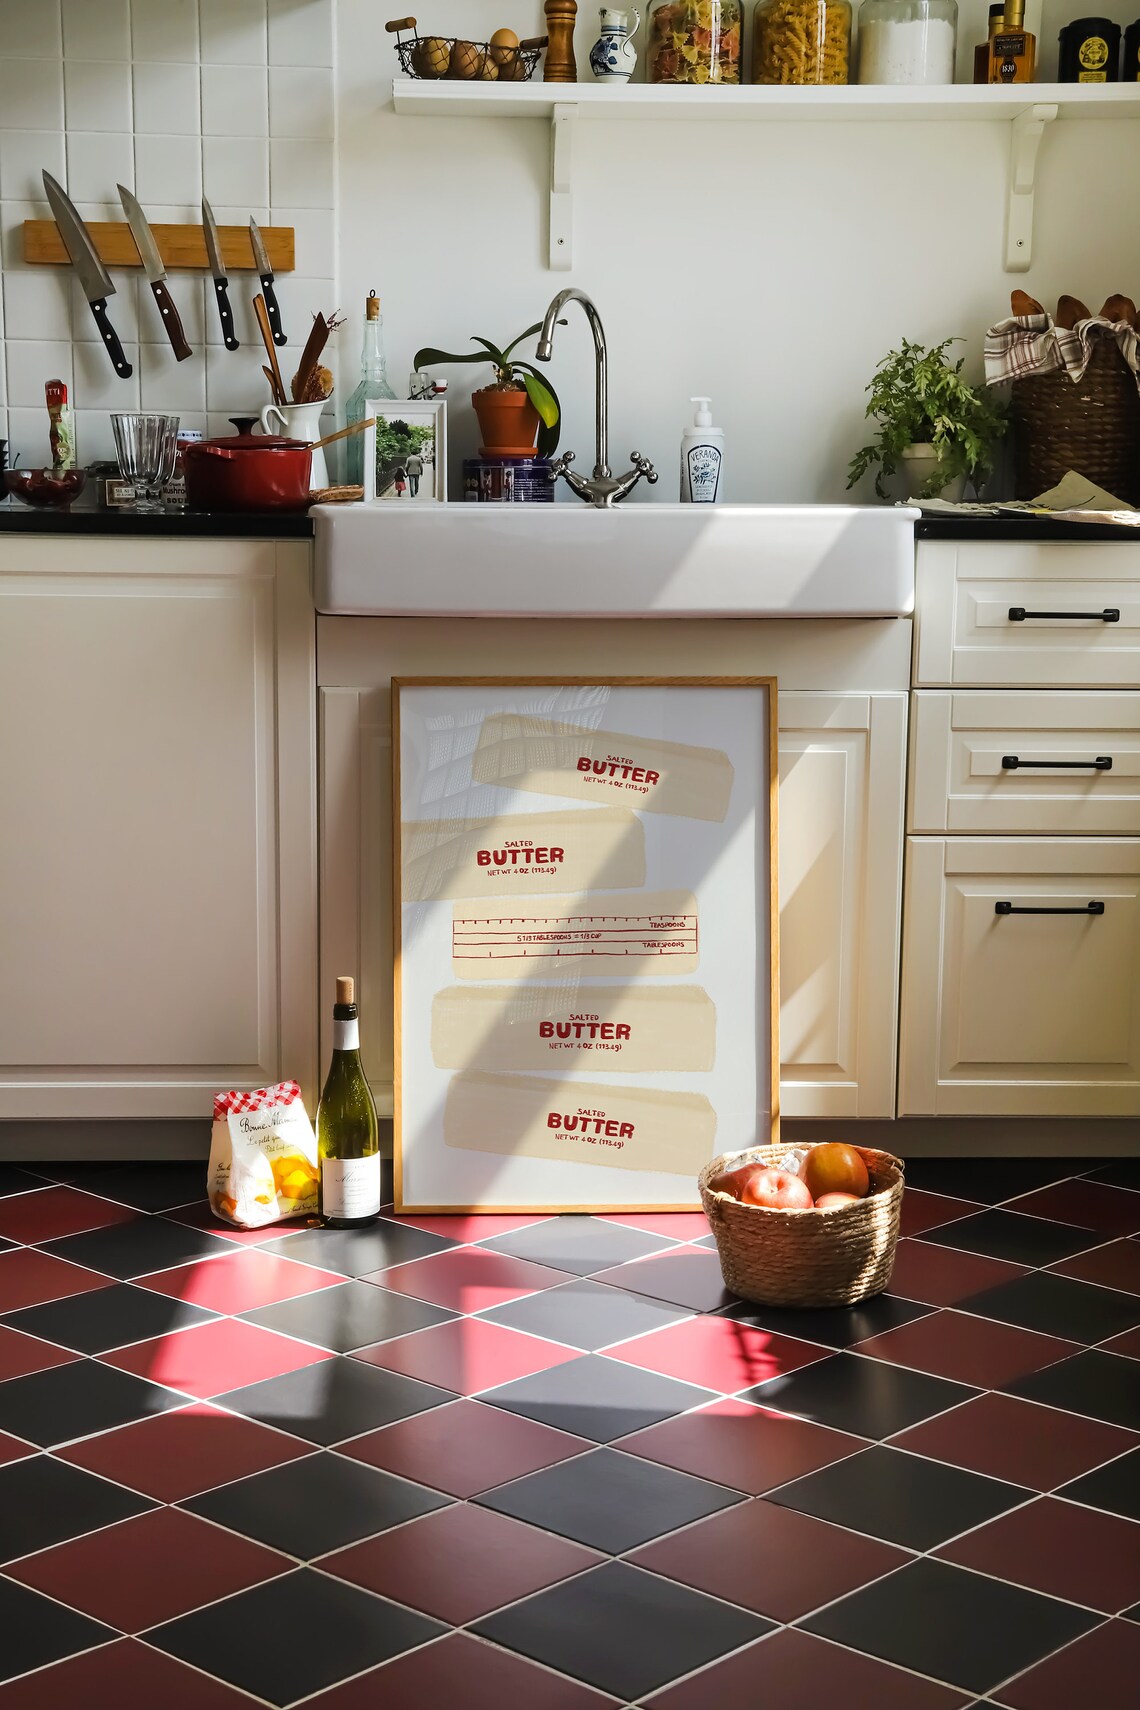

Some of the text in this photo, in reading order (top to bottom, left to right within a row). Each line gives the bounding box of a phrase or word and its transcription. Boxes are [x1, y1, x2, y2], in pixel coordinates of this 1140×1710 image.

[690, 449, 720, 463] VERANDA
[162, 486, 186, 495] Mushro
[606, 755, 634, 765] SALTED
[577, 757, 660, 785] BUTTER
[614, 780, 623, 788] OZ
[504, 840, 533, 848] SALTED
[476, 847, 564, 866] BUTTER
[649, 921, 686, 929] TEASPOONS
[533, 933, 572, 941] TABLESPOONS
[539, 1021, 631, 1040] BUTTER
[577, 1108, 606, 1117] SALTED
[239, 1117, 267, 1133] Bonne
[547, 1112, 635, 1139] BUTTER
[587, 1136, 597, 1144] OZ
